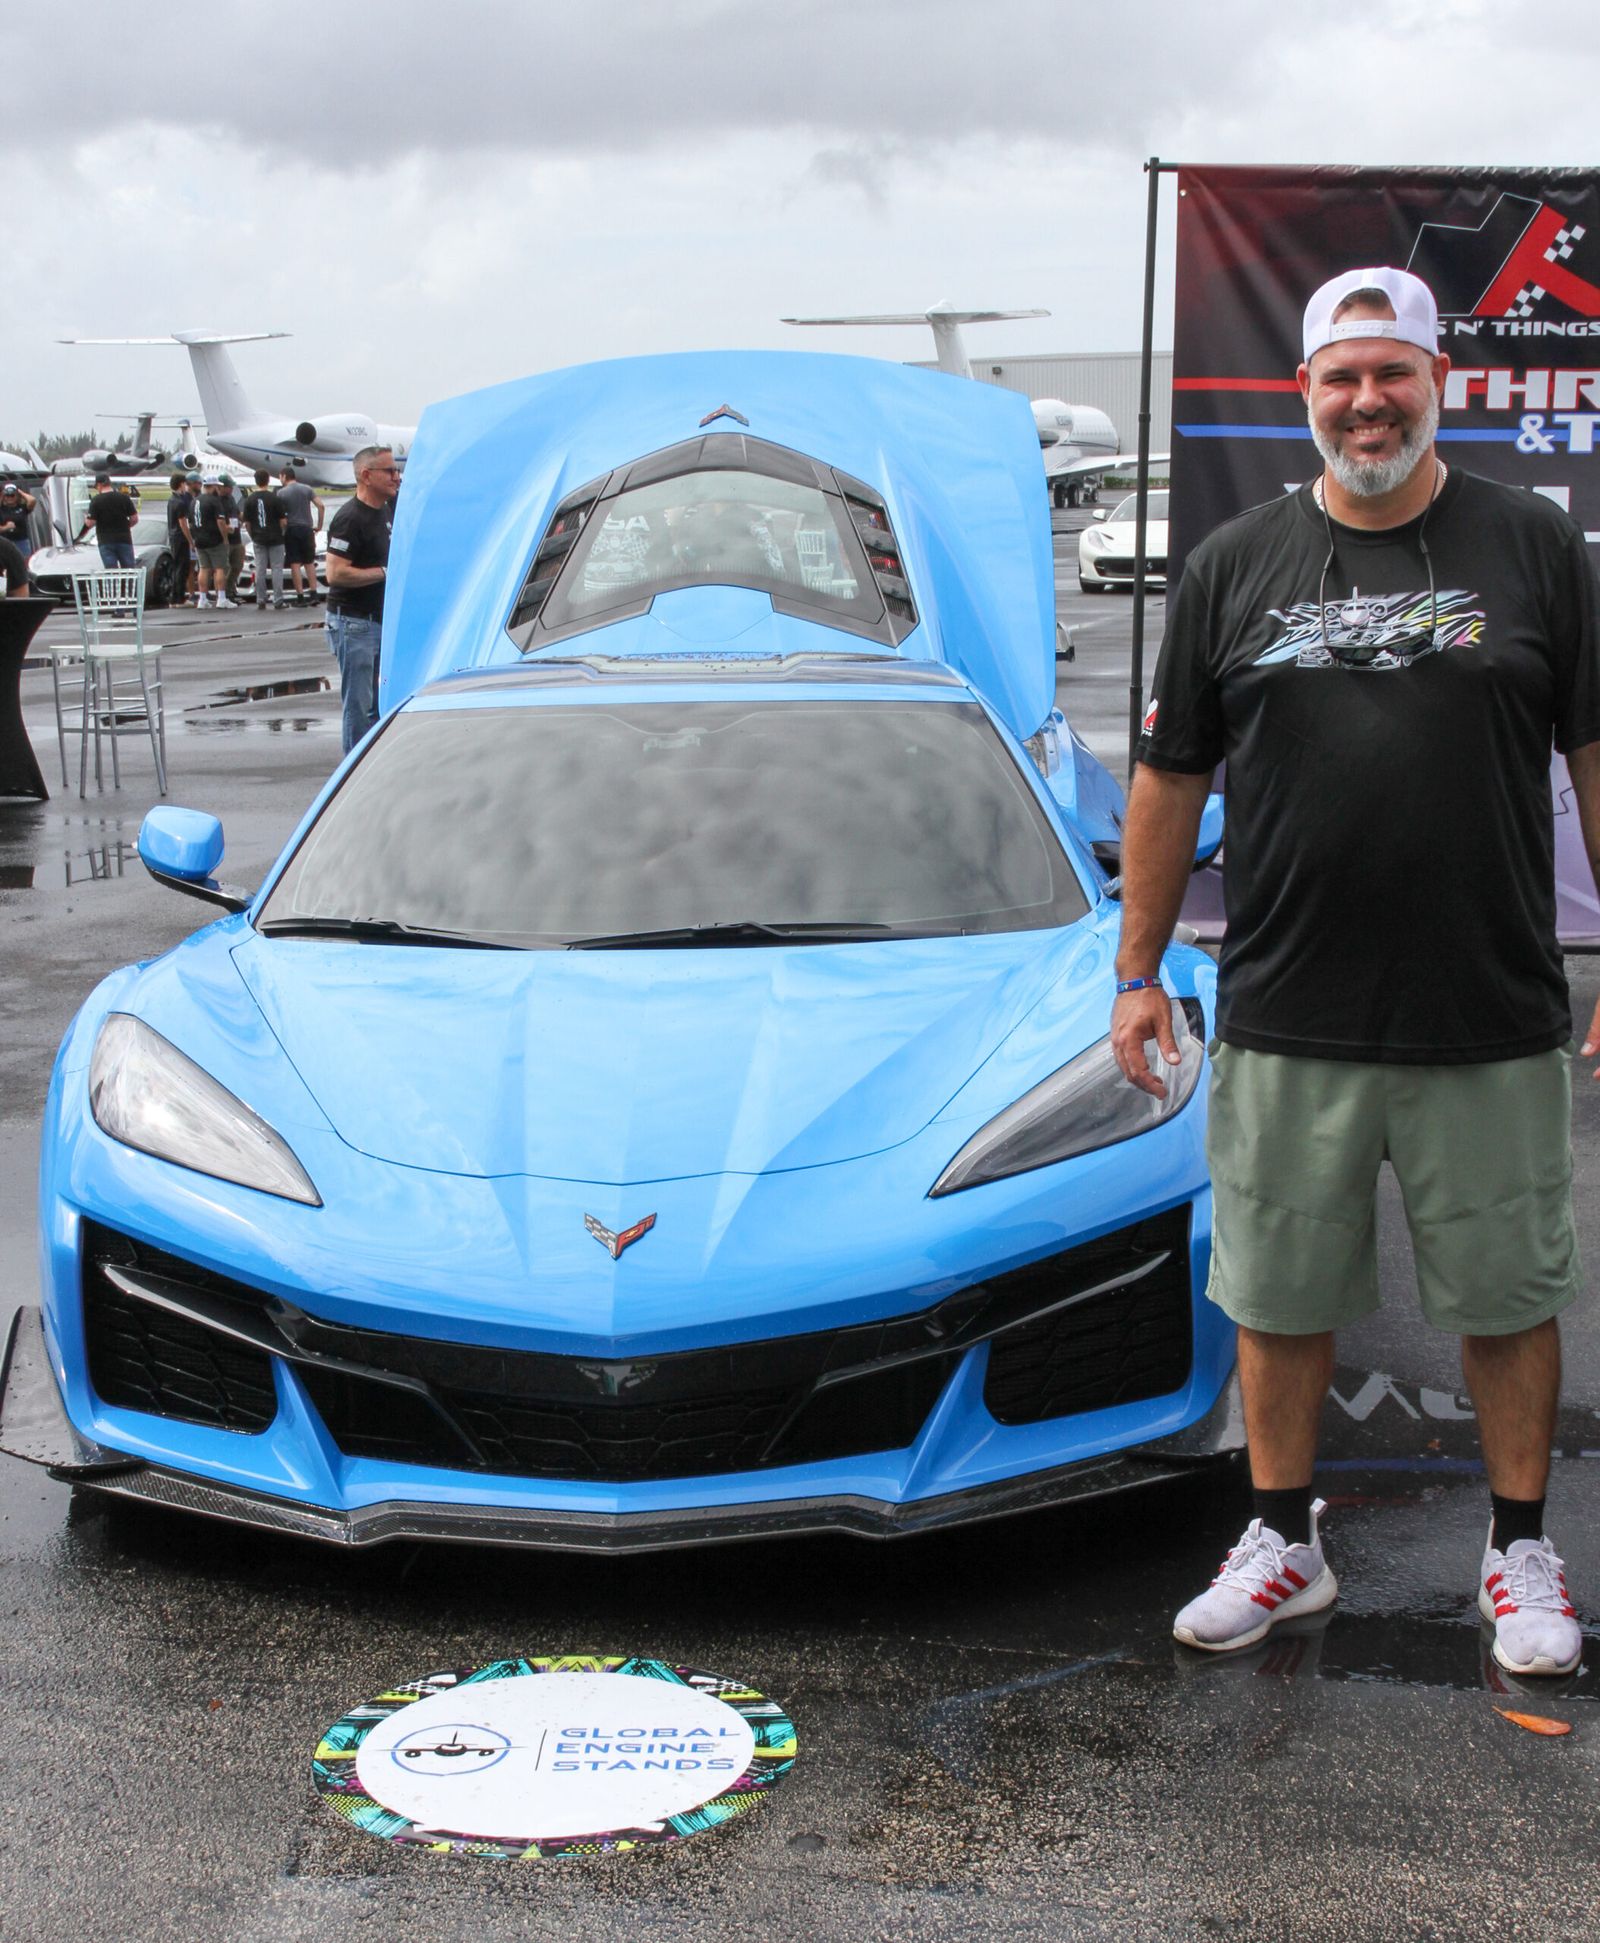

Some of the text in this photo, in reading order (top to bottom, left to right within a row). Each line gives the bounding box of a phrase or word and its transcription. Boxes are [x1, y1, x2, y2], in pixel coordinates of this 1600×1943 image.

[561, 1727, 741, 1739] GLOBAL
[556, 1742, 716, 1754] ENGINE
[552, 1758, 735, 1772] STANDS
